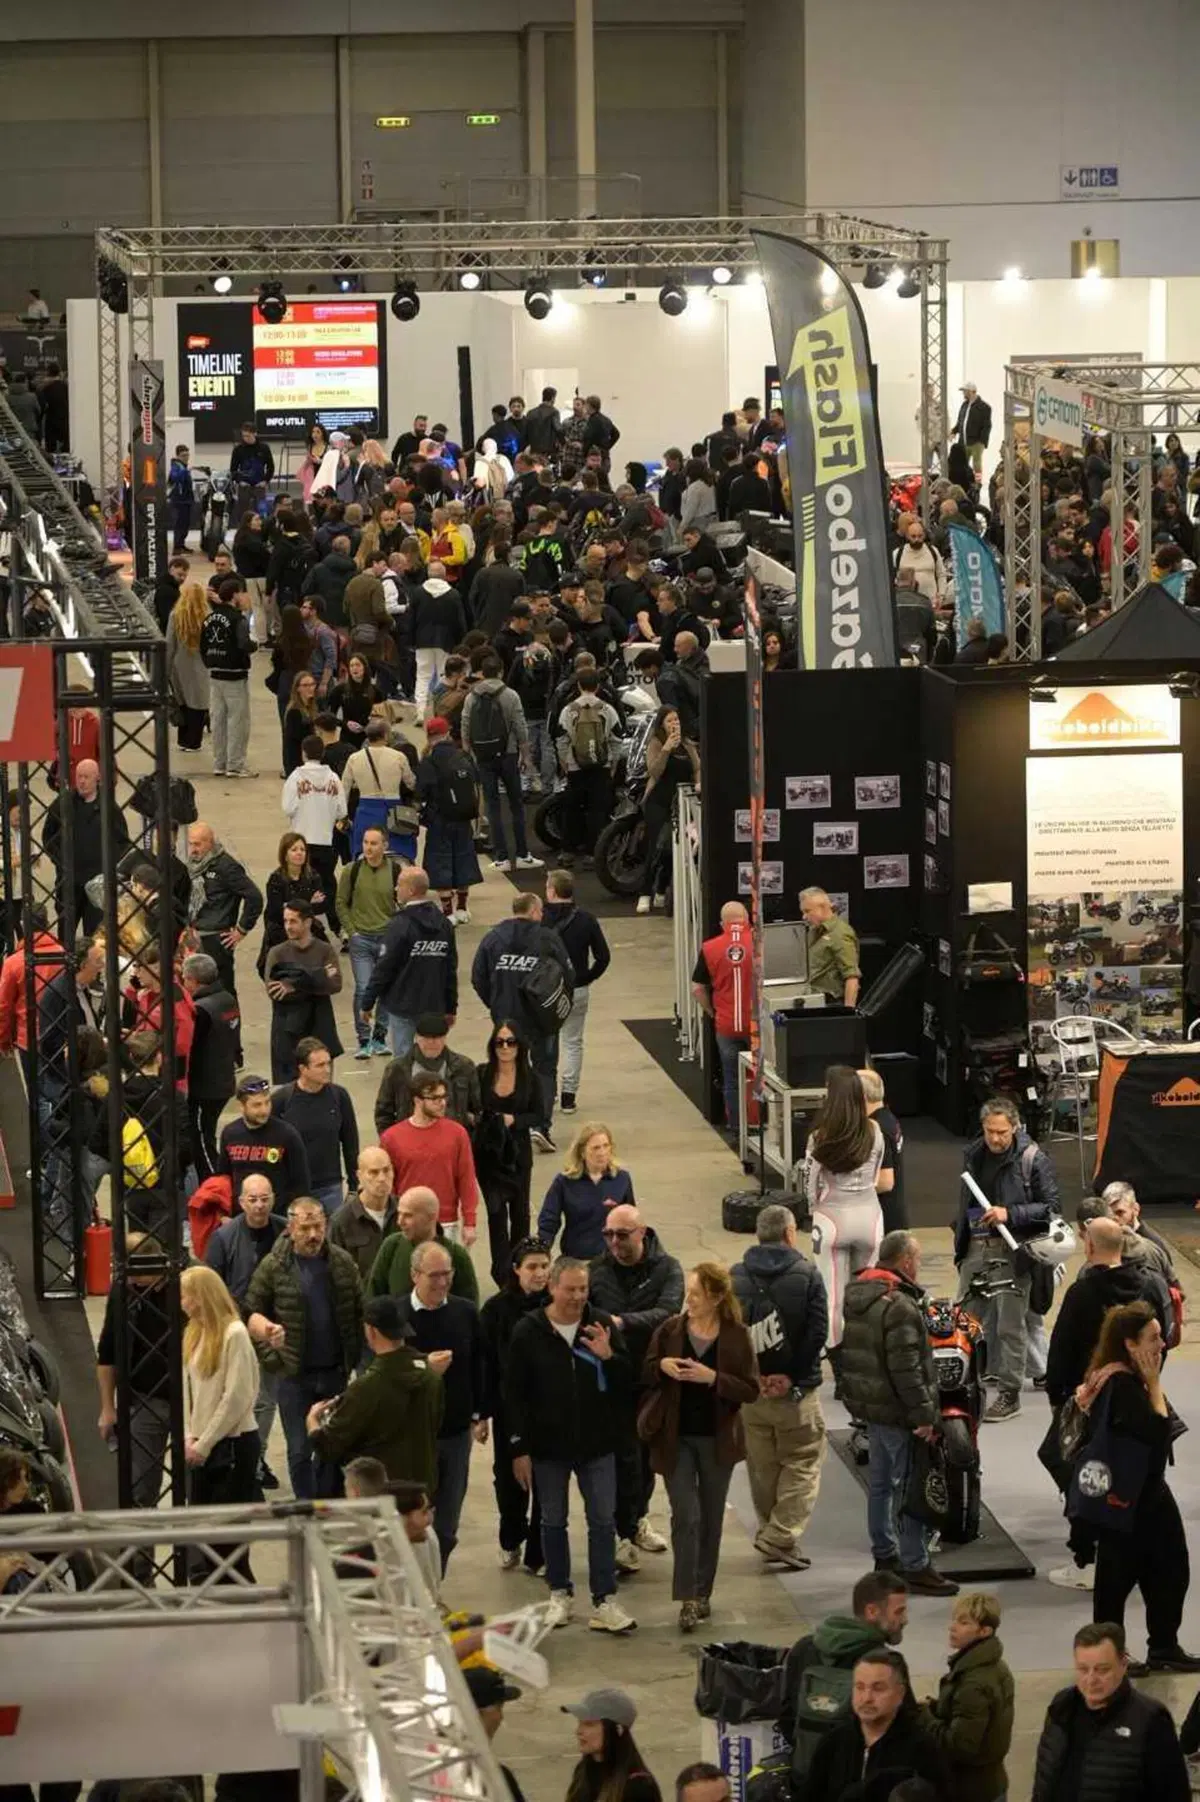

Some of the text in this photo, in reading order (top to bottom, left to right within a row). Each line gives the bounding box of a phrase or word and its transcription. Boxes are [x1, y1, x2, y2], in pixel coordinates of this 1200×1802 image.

[187, 354, 242, 375] TIMELINE
[189, 376, 235, 397] EVENTI
[142, 374, 154, 443] motodays
[266, 418, 285, 426] INFO
[147, 503, 157, 578] REATIVE LAB
[411, 941, 448, 952] STAFF
